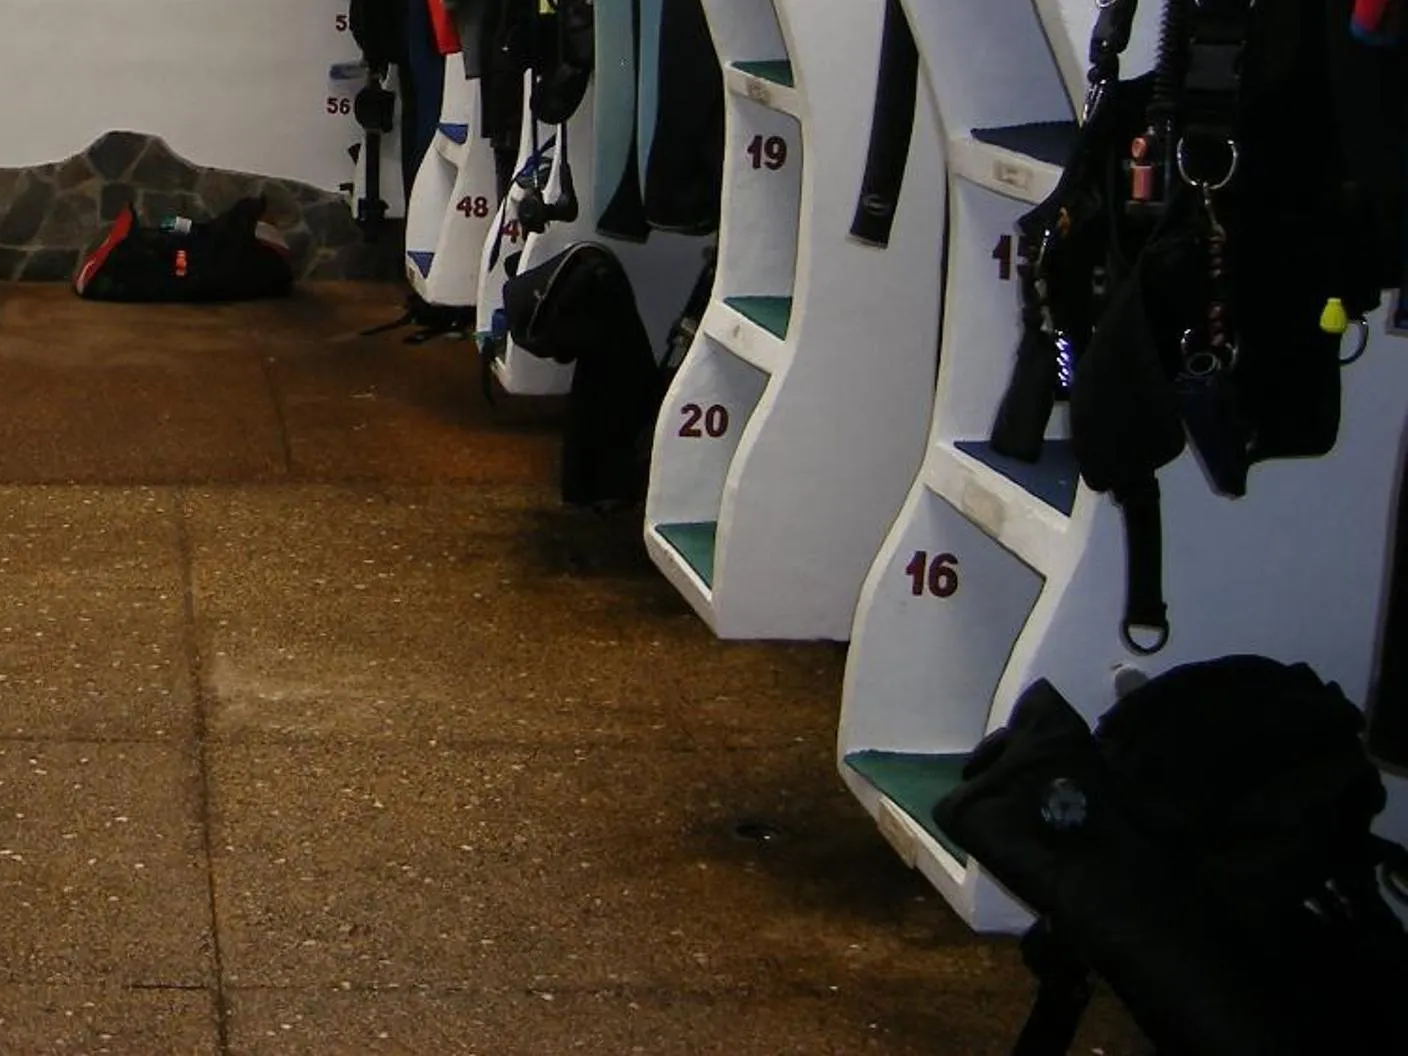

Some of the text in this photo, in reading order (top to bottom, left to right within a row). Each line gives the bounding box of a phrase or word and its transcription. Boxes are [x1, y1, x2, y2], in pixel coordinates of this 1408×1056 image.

[336, 15, 348, 32] 5
[327, 98, 350, 115] 56
[747, 135, 787, 170] 19
[456, 196, 489, 218] 48
[502, 219, 527, 242] 4
[679, 404, 729, 438] 20
[906, 551, 958, 598] 16
